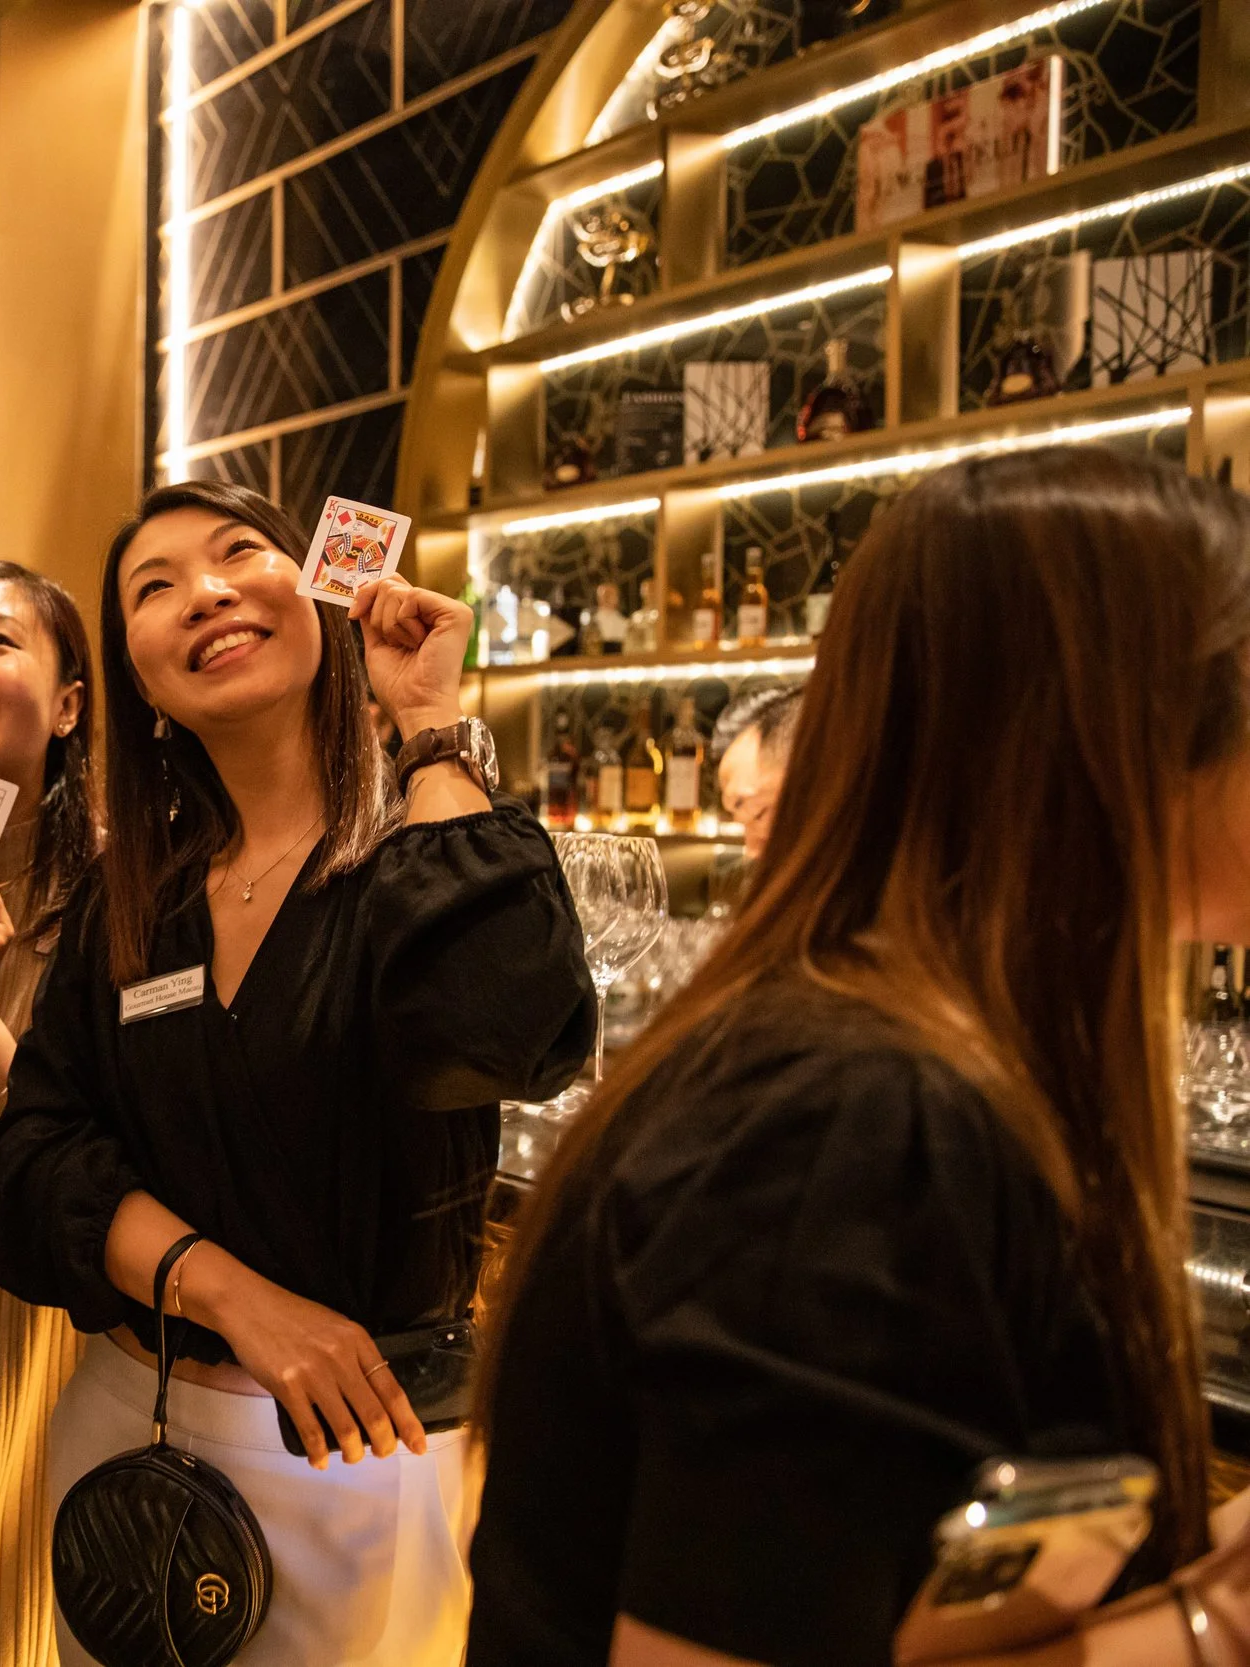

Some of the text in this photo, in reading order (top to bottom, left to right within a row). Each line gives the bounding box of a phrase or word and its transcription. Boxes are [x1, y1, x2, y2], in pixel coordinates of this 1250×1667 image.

[328, 500, 338, 511] K
[133, 975, 194, 999] Carman Ying
[155, 992, 177, 1003] House
